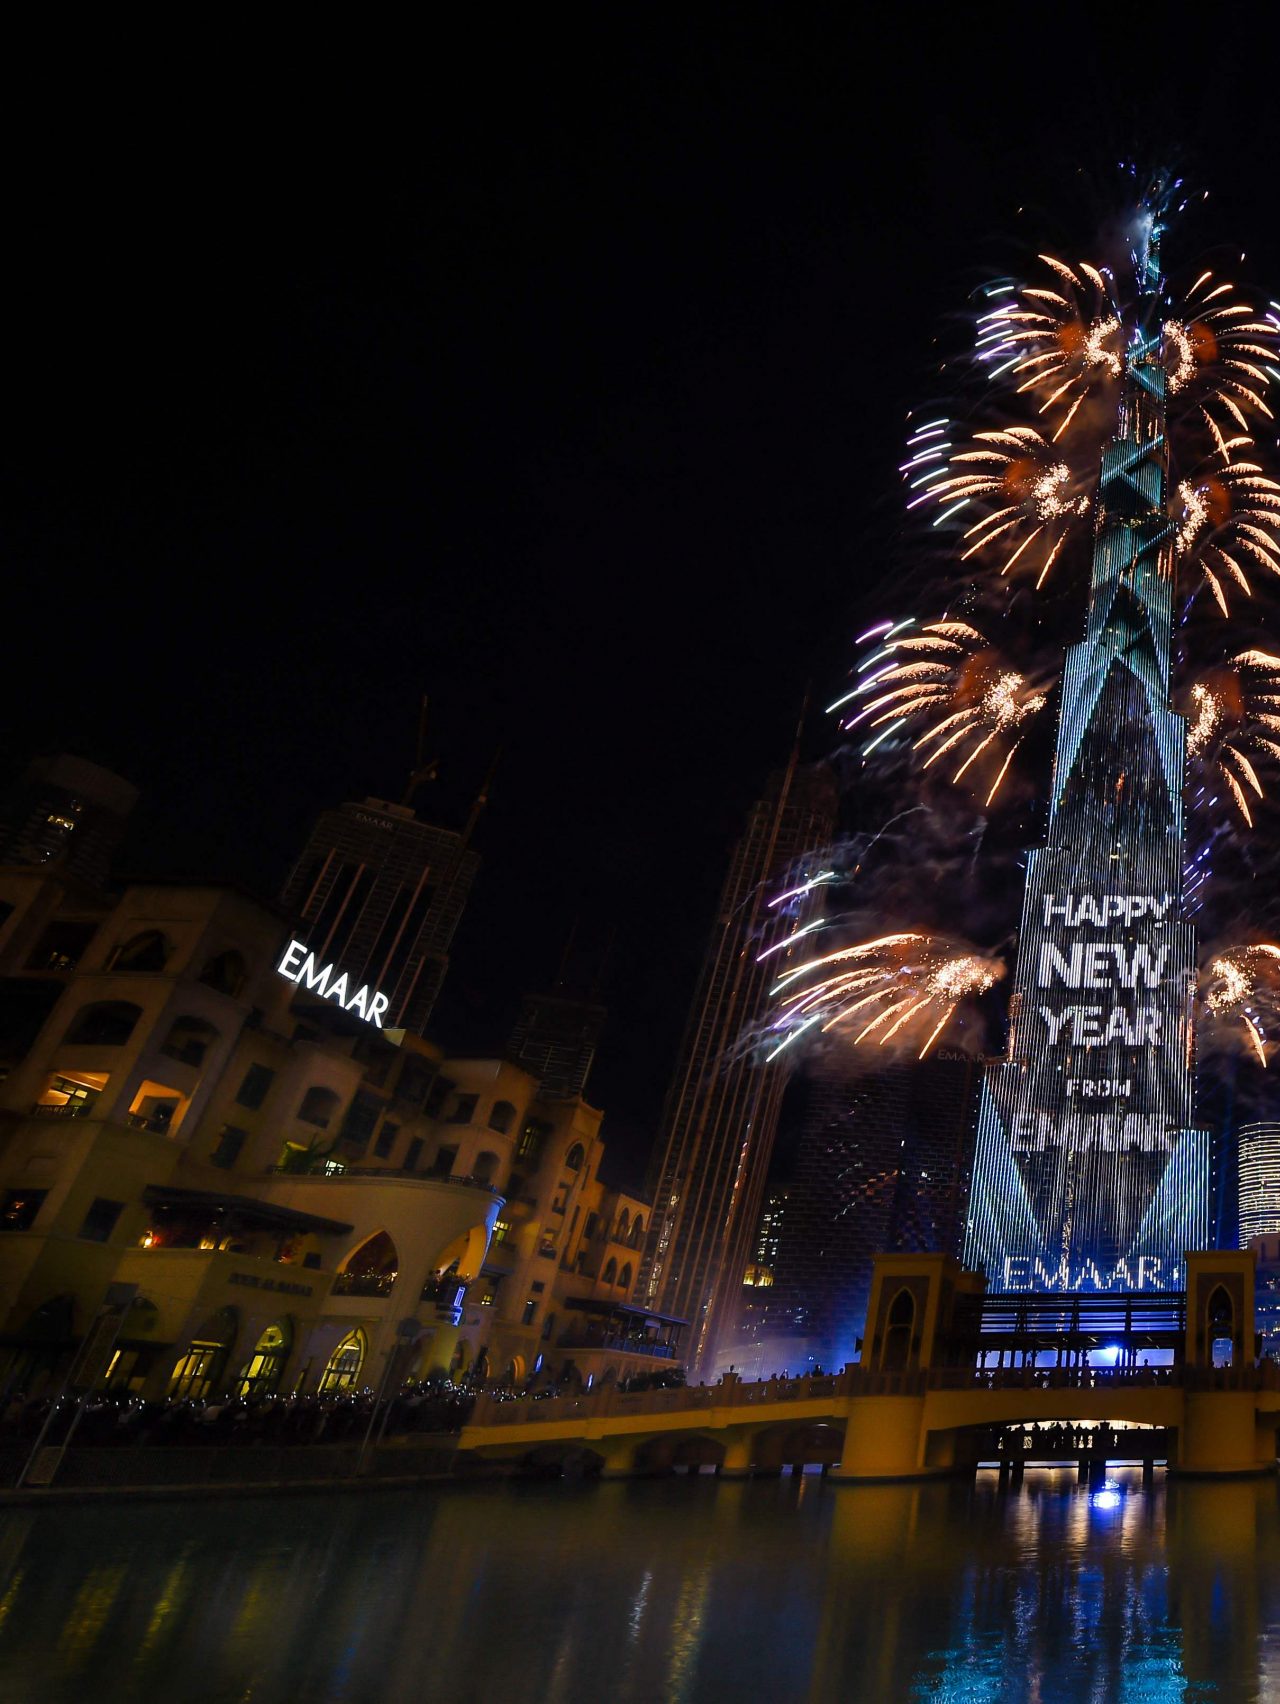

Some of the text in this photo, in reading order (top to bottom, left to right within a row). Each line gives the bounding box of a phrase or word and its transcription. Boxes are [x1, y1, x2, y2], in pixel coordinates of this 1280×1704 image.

[1043, 894, 1172, 927] HAPPY
[277, 939, 389, 1029] EMAAR
[1038, 943, 1171, 989] NEW
[1040, 1005, 1164, 1046] YEAR
[1066, 1079, 1131, 1097] FROM
[1003, 1256, 1165, 1290] EMAAR
